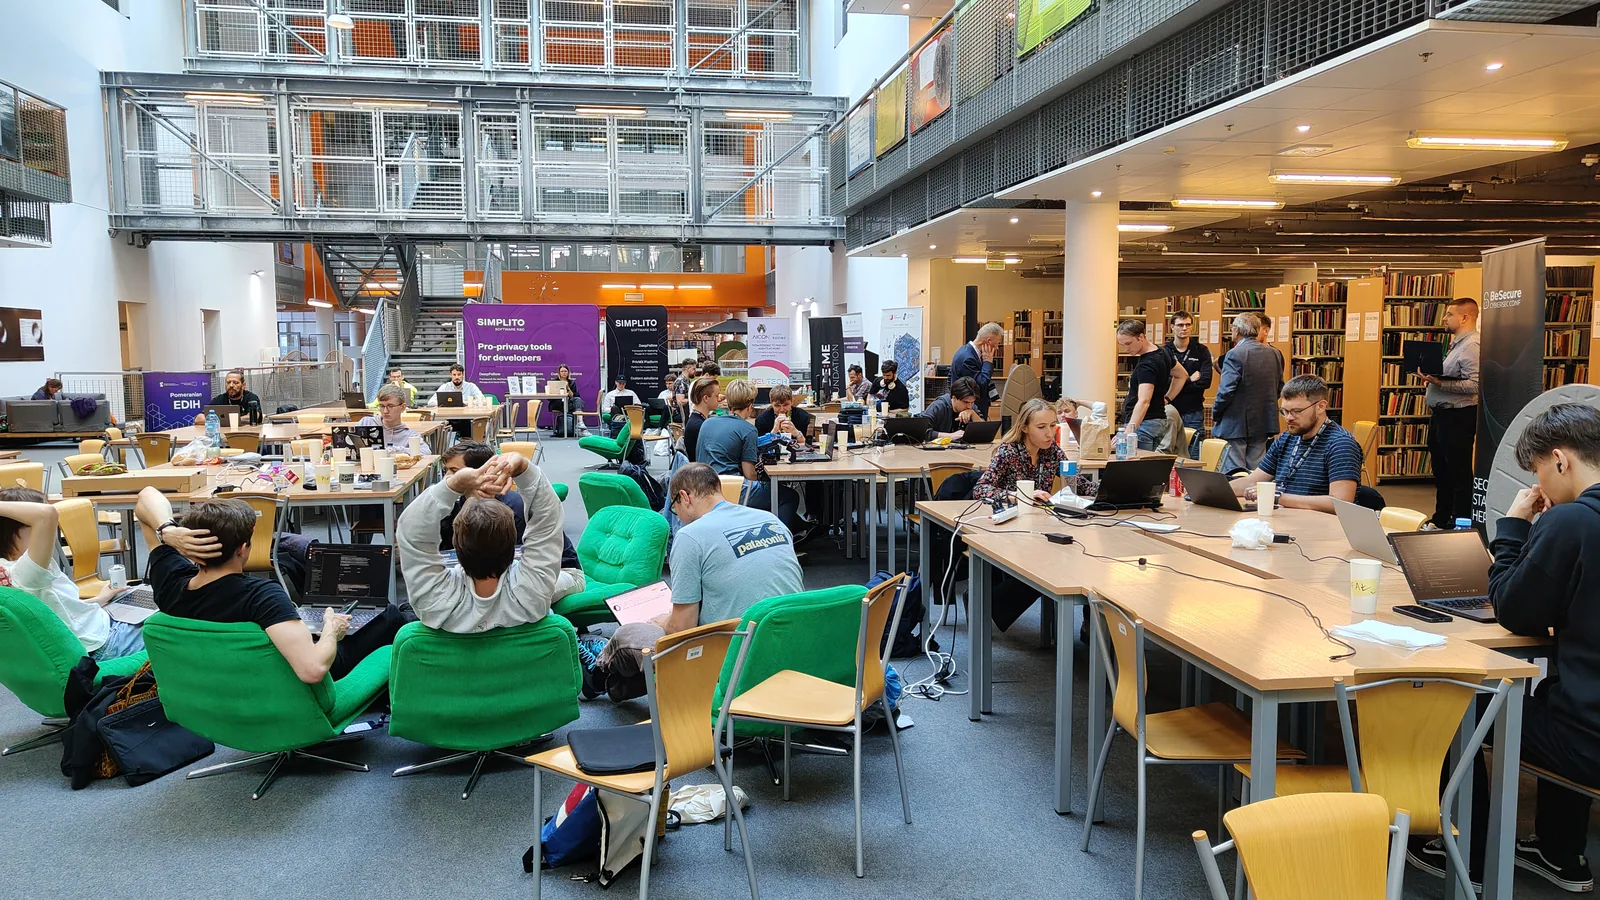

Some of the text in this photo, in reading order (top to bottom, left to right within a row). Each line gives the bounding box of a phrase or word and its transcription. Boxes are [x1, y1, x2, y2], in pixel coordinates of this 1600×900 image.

[1490, 289, 1522, 301] BeSecure
[477, 318, 525, 327] SIMPLITO
[615, 319, 658, 327] SIMPLITO
[477, 343, 552, 352] Pro-privacy tools
[493, 354, 542, 362] developers
[832, 344, 840, 393] UNDATION
[173, 400, 201, 410] EDIH
[1473, 477, 1488, 491] SEC
[1472, 493, 1486, 507] STA
[736, 533, 786, 556] patagonia
